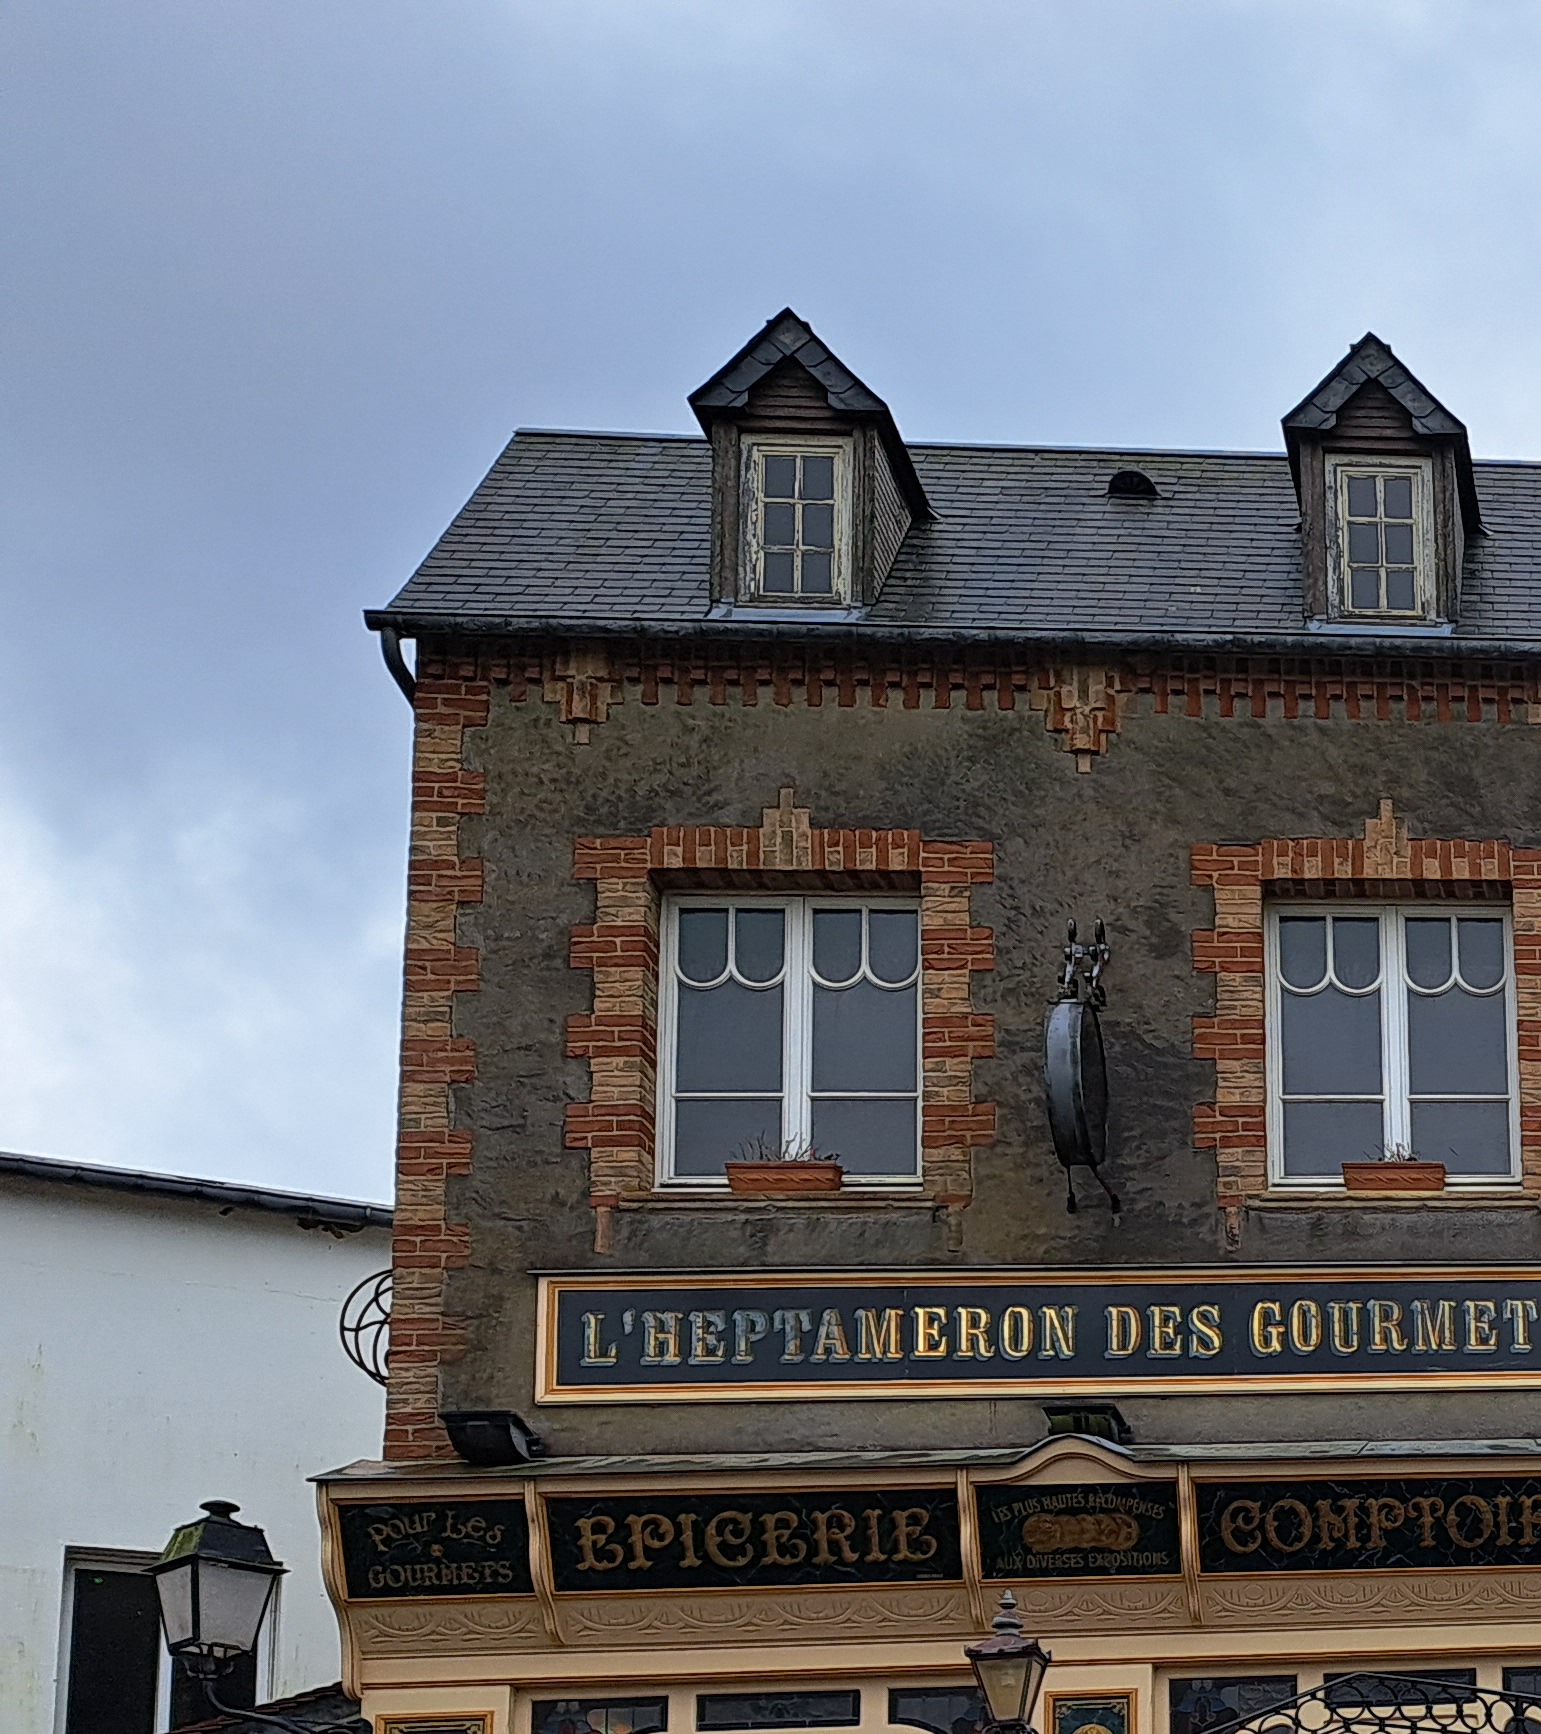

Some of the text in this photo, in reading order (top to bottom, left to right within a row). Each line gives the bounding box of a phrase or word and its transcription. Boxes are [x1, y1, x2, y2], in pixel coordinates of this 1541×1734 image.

[578, 1304, 1080, 1368] L'HEPTAMERON
[1103, 1304, 1224, 1360] DES
[991, 1505, 1012, 1524] LES
[1013, 1498, 1042, 1517] PLUS
[1042, 1493, 1086, 1511] HAUTES
[574, 1506, 939, 1572] EPICERIE
[367, 1560, 514, 1589] GOURMETS
[996, 1551, 1171, 1570] AUX DIVERSES EXPOSITIONS
